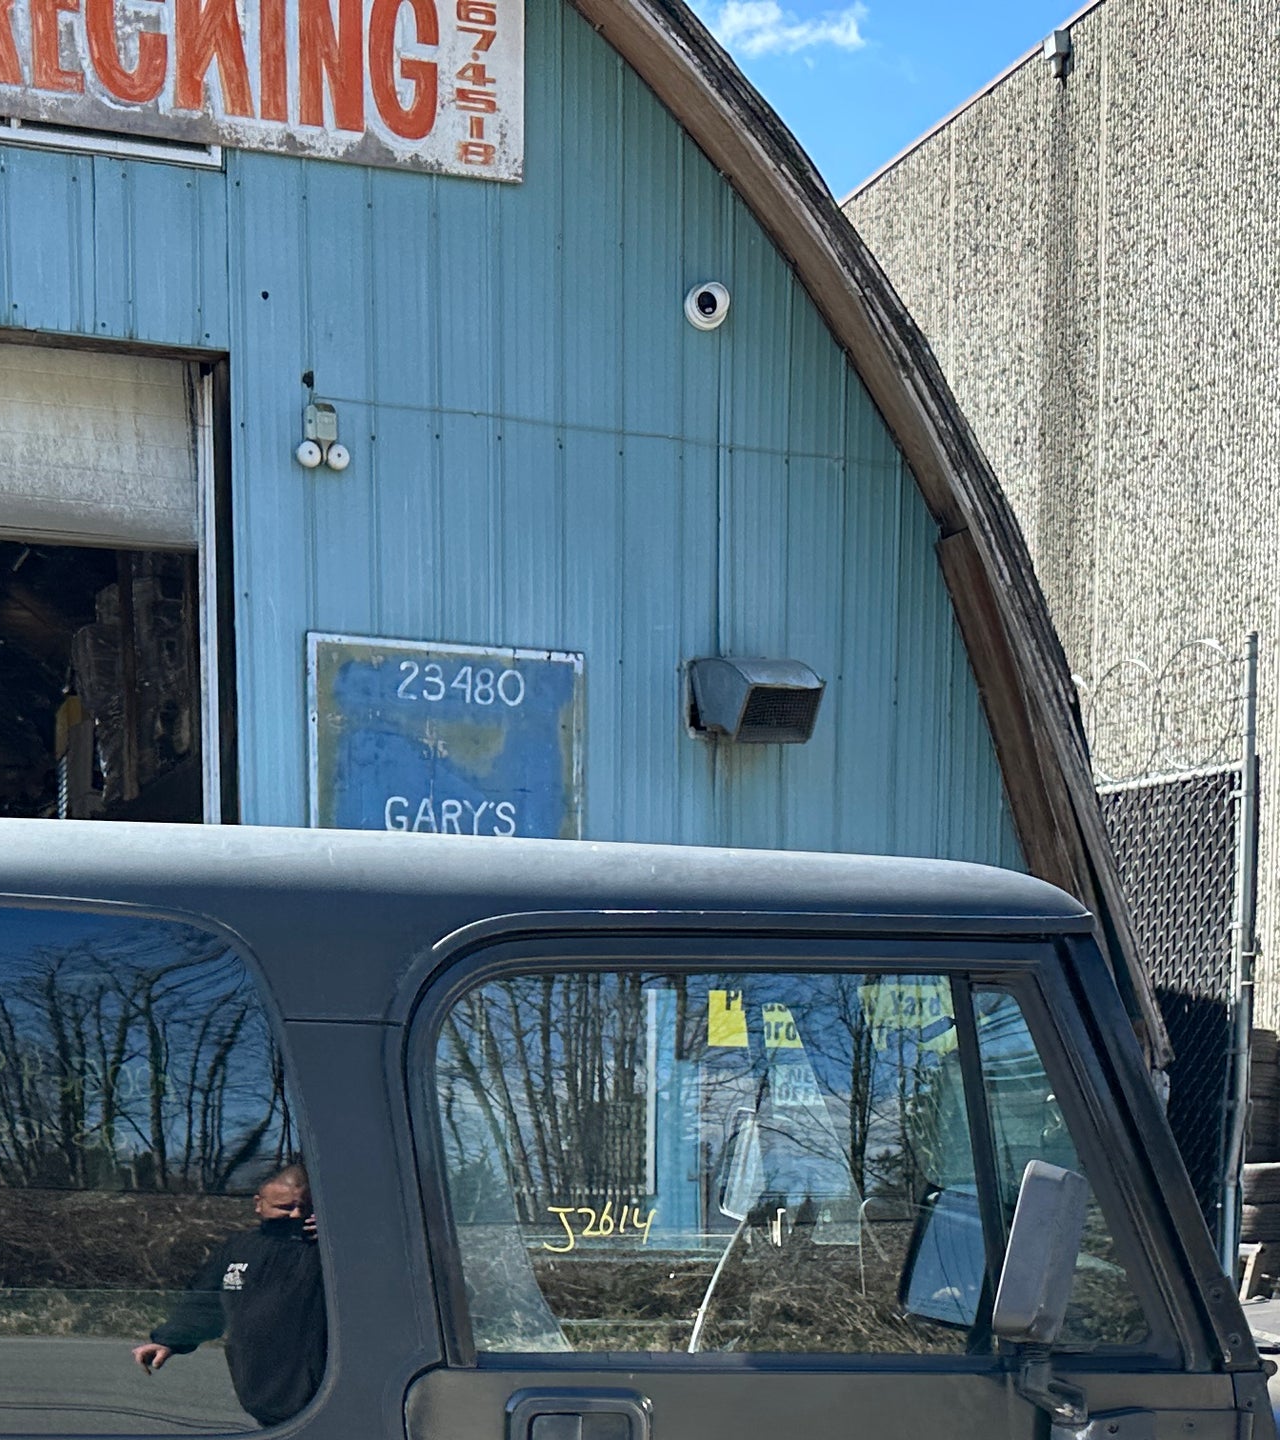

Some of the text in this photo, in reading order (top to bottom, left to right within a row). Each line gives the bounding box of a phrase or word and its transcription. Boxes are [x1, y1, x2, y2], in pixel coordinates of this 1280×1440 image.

[398, 661, 525, 707] 23480
[385, 796, 517, 837] GARY'S
[543, 1204, 657, 1252] J2614
